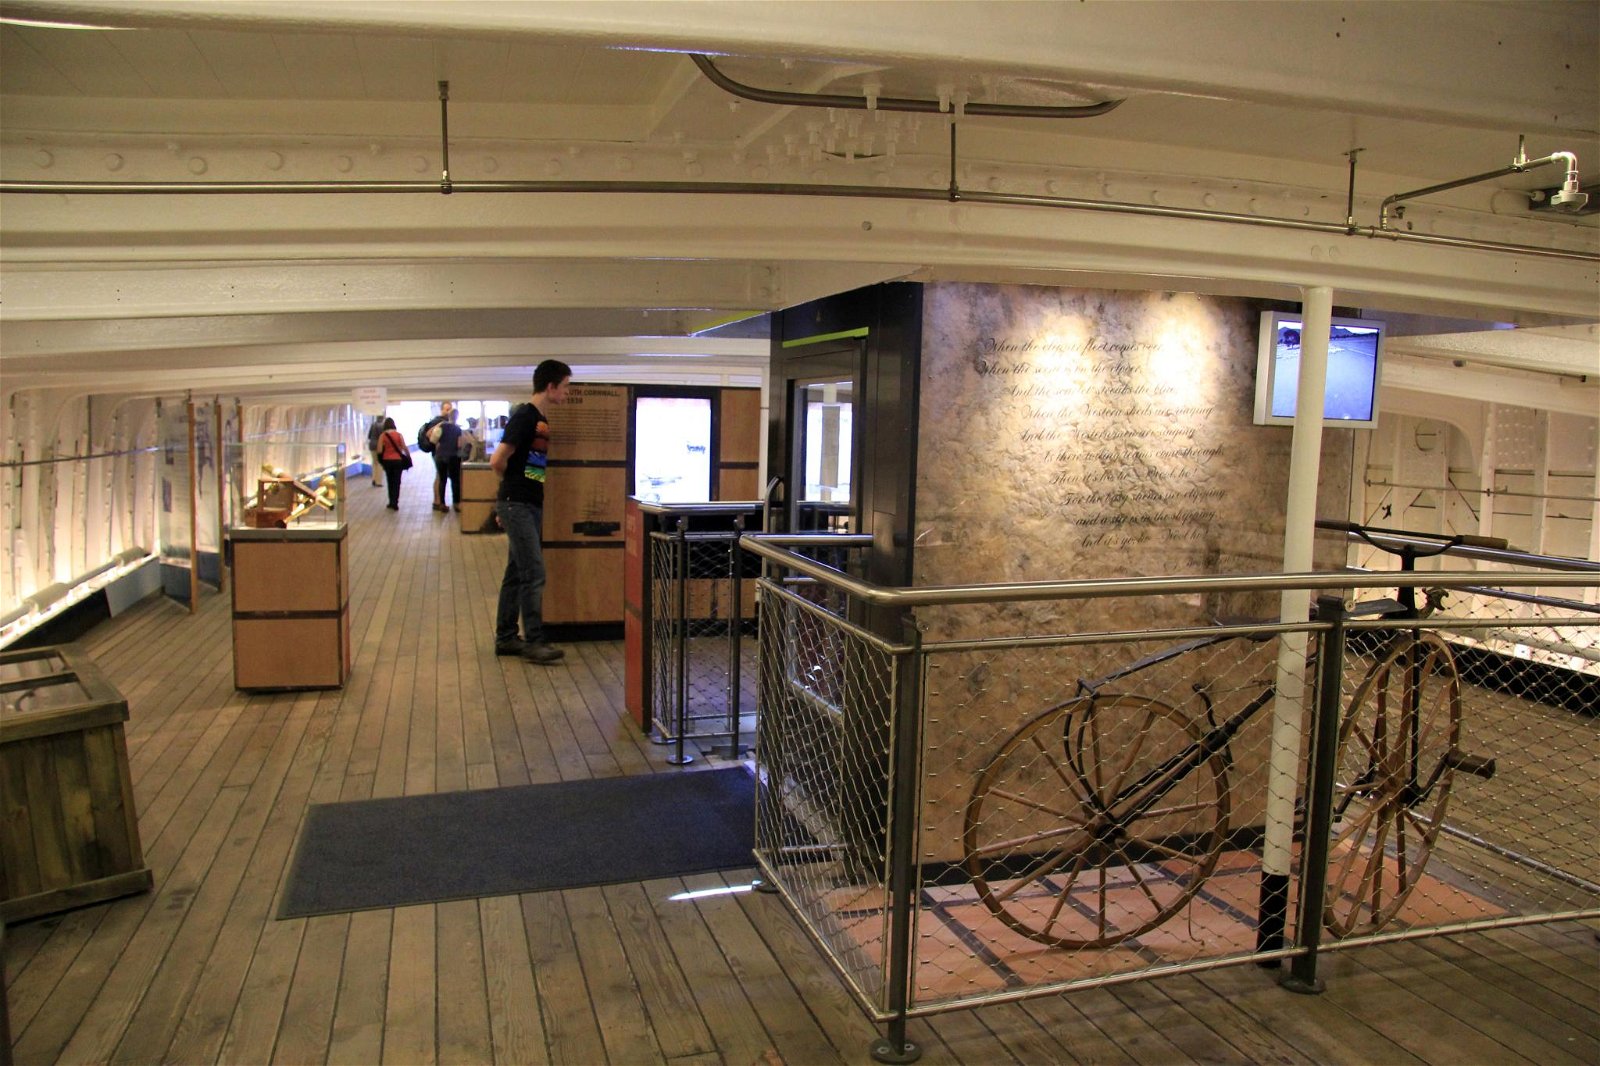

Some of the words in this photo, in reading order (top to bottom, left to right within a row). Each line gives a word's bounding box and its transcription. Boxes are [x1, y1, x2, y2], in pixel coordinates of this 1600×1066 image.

[985, 337, 1018, 352] When
[1021, 339, 1039, 352] the
[978, 359, 1010, 376] When
[1013, 361, 1031, 374] the
[1009, 385, 1034, 397] And
[1034, 385, 1051, 396] the
[1134, 383, 1150, 395] the
[1022, 404, 1055, 418] When
[1057, 406, 1073, 417] the
[1019, 428, 1046, 442] And
[1045, 430, 1061, 440] the
[1049, 469, 1081, 484] Then
[1061, 492, 1085, 505] For
[1075, 512, 1101, 526] and
[1154, 510, 1170, 521] the
[1080, 533, 1106, 548] And
